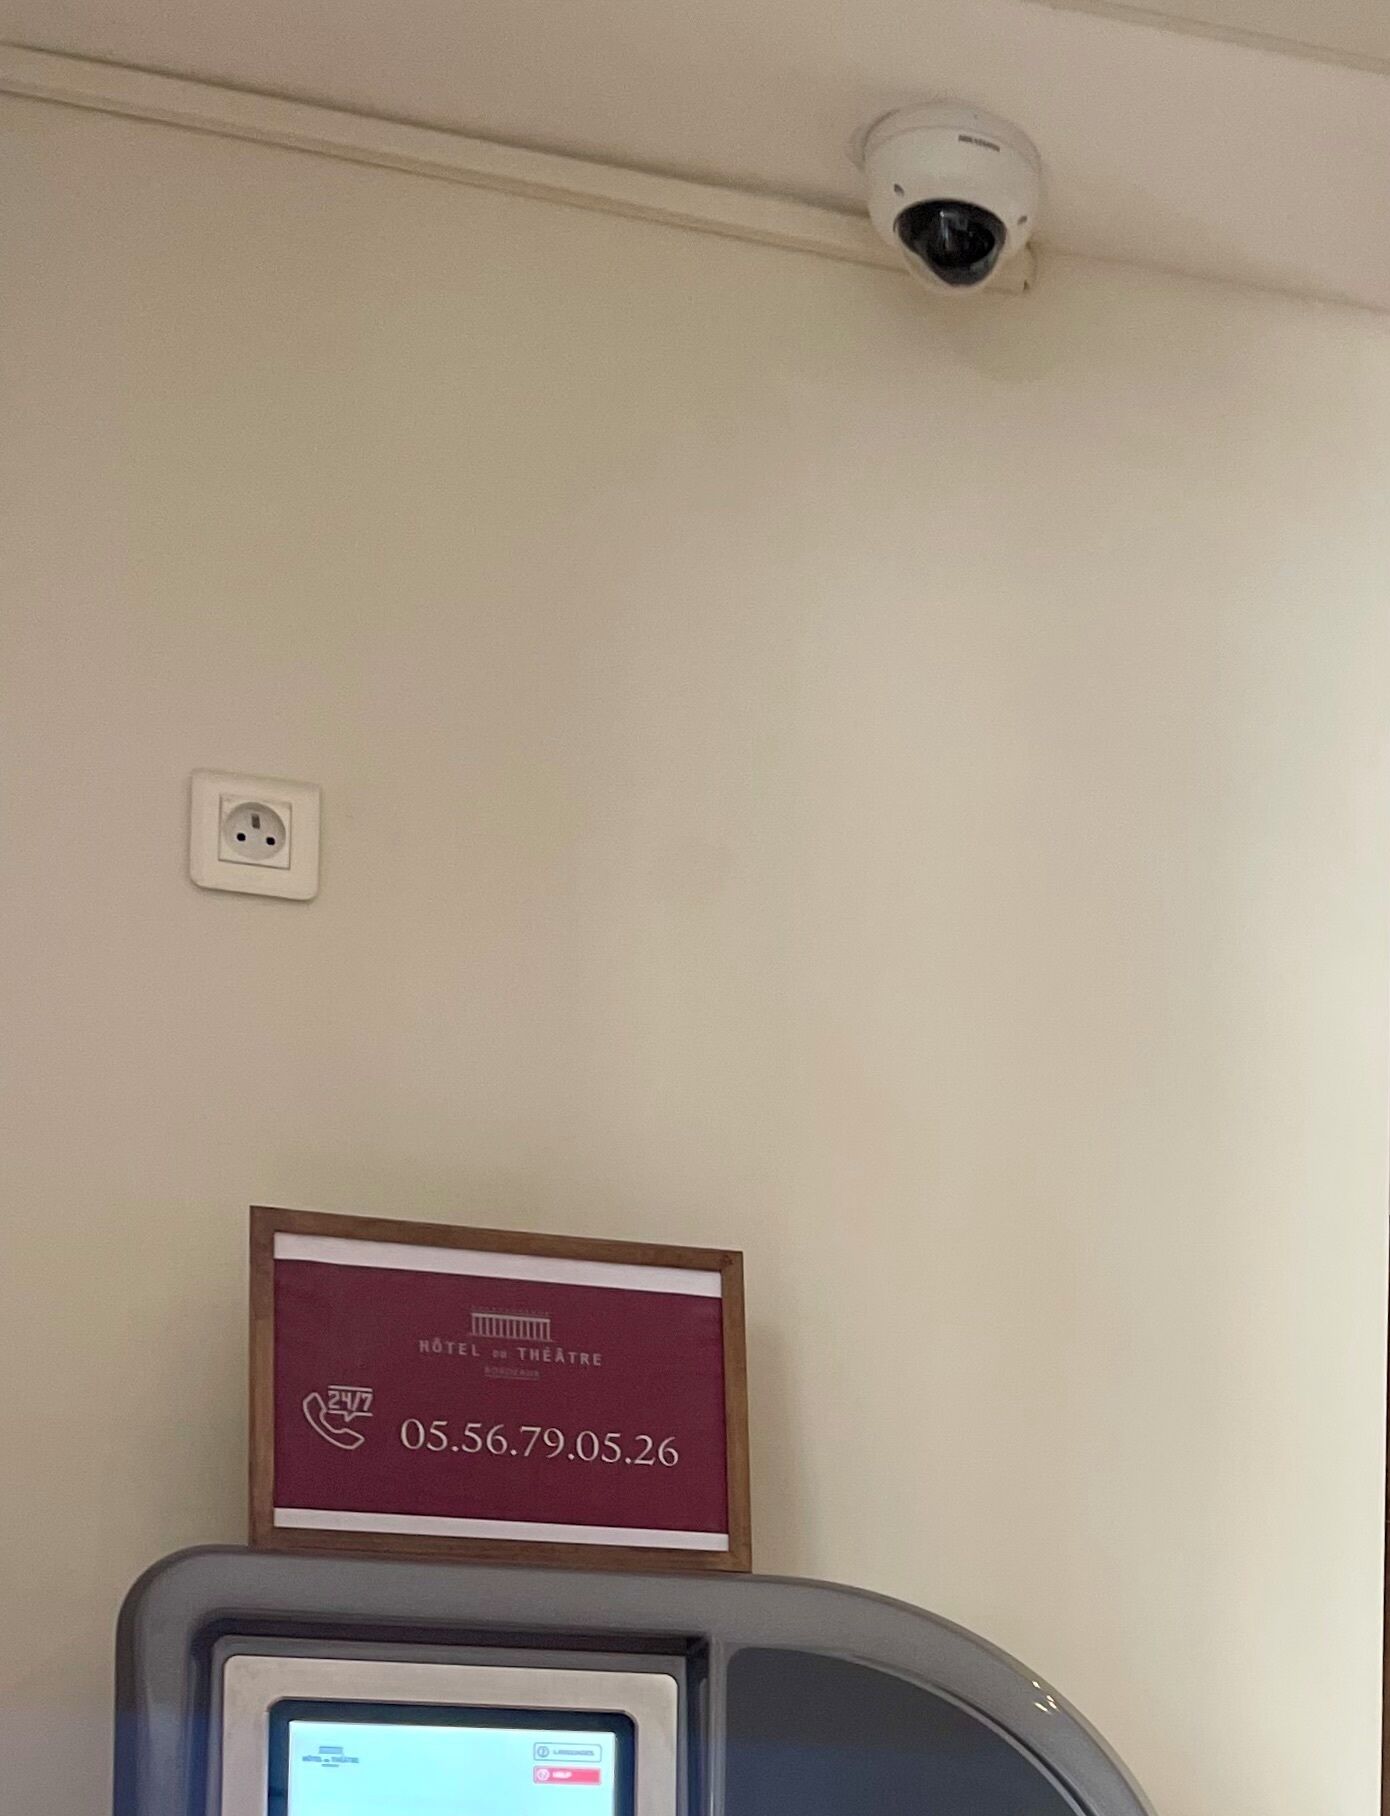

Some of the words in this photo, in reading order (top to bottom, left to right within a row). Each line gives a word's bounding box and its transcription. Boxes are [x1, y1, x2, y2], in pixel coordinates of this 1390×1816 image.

[417, 1337, 480, 1357] HÔTEL
[516, 1345, 603, 1367] THÉÂTRE
[328, 1391, 373, 1411] 24/7
[400, 1417, 679, 1467] 05.56.79.05.26
